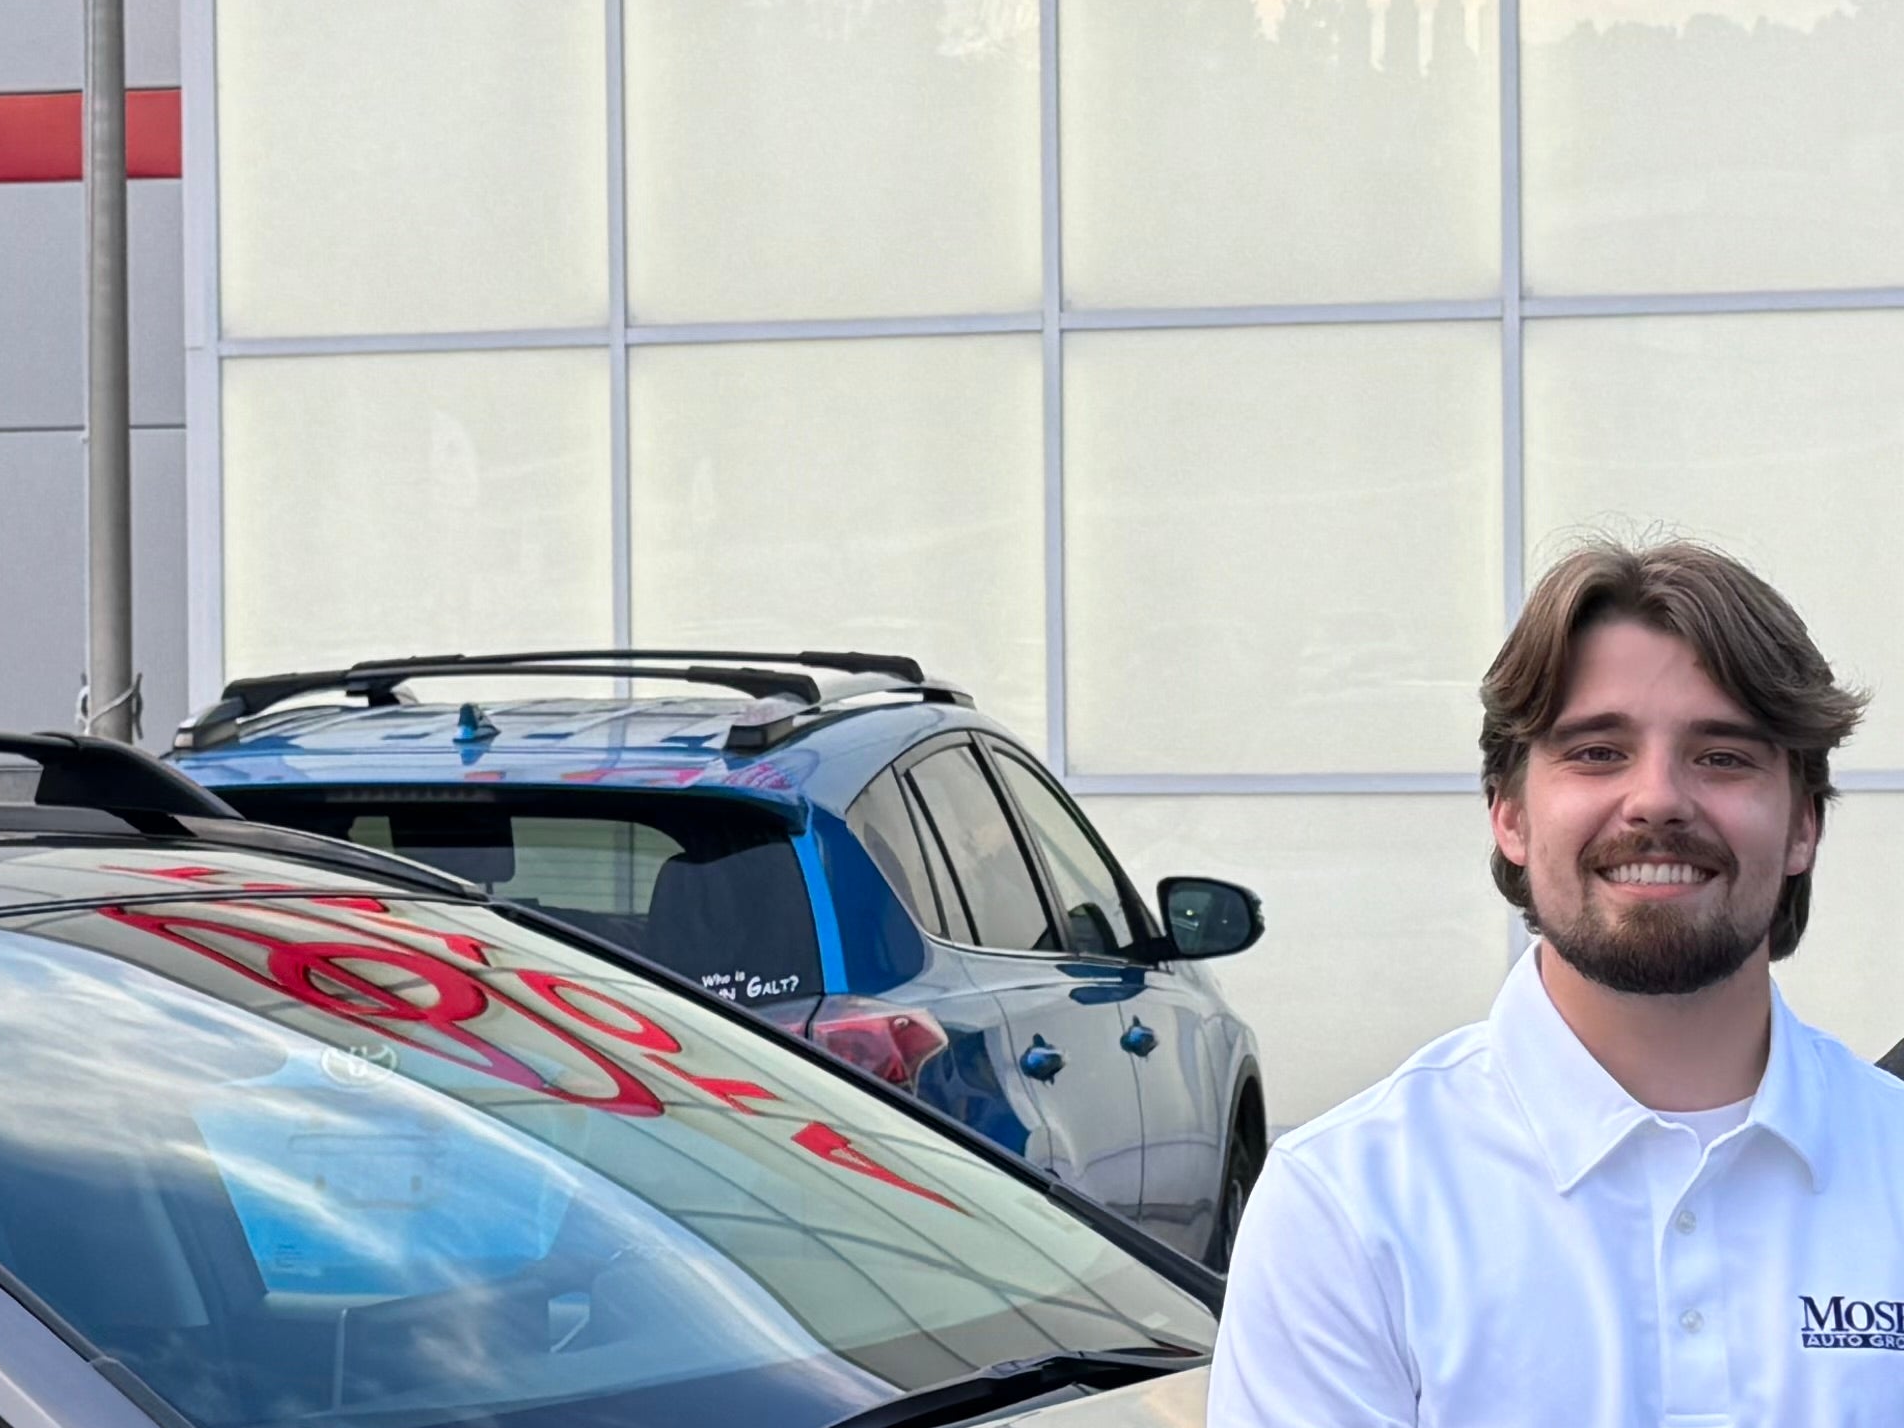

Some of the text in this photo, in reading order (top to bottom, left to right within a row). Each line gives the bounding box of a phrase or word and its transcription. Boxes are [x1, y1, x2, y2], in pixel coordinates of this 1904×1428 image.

[701, 970, 746, 988] Who is
[1806, 1334, 1863, 1347] AUTO
